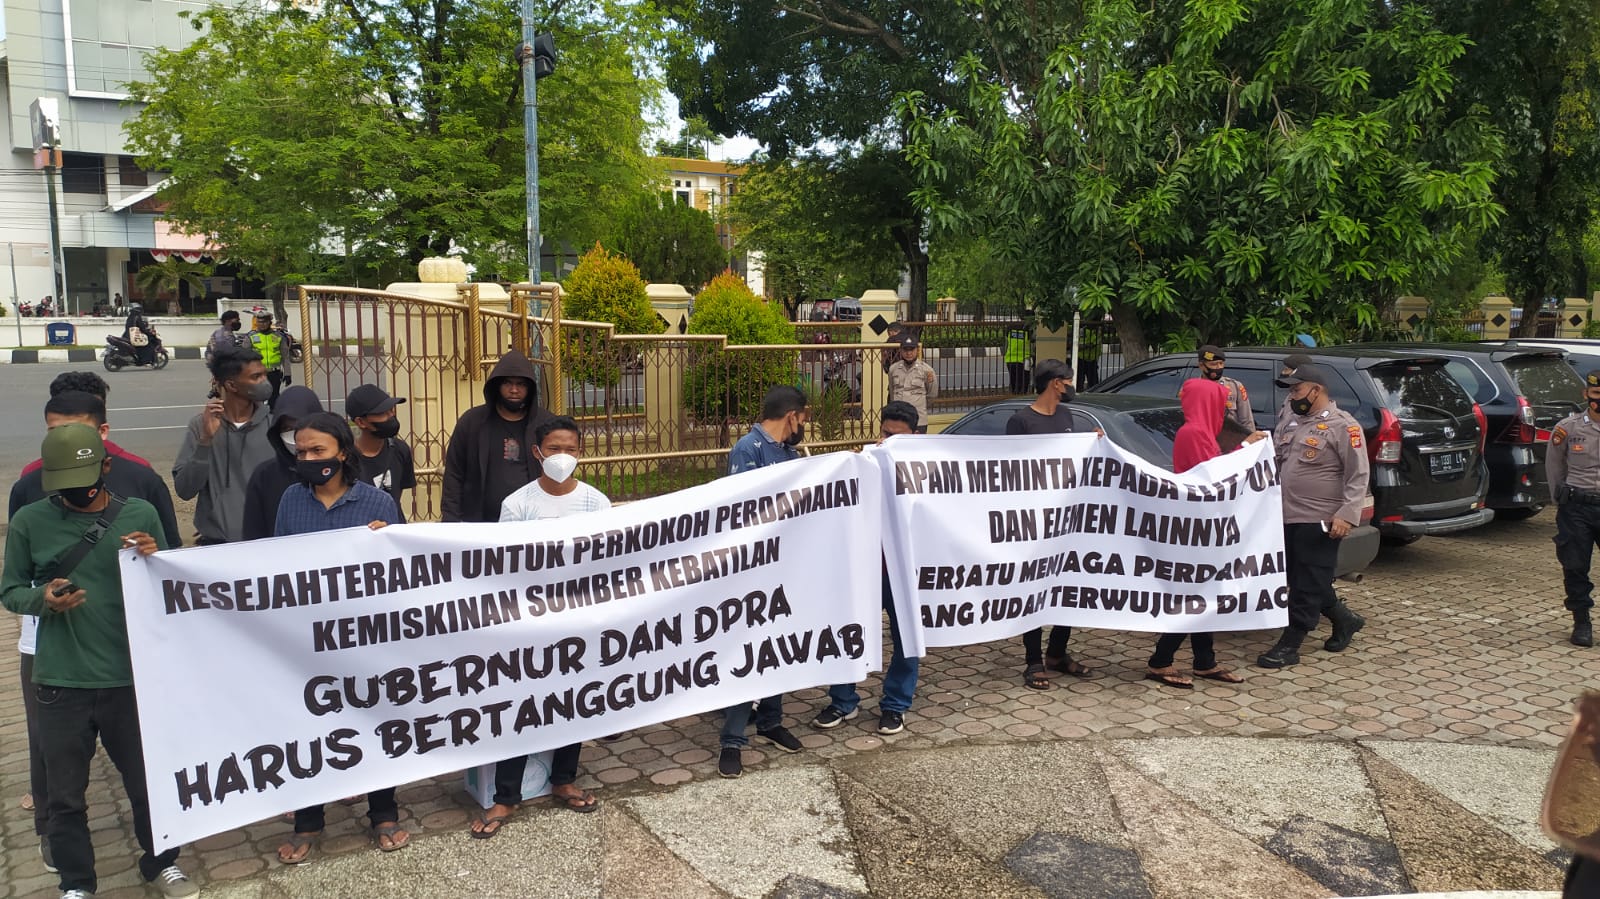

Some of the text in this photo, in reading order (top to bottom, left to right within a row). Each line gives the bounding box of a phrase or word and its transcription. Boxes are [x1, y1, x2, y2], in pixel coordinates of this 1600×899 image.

[966, 457, 1077, 494] MEMINTA
[1079, 456, 1179, 501] KEPADA
[162, 477, 860, 615] KESEJAHTERAAN UNTUK PERKOKOH PERDAMAIAN
[988, 503, 1241, 547] DAN ELEMEN LAINNYA
[313, 535, 781, 652] KEMISKINAN SUMBER KEBATILAN
[915, 561, 1015, 591] ERSATU
[1019, 551, 1126, 583] MENJAGA
[980, 589, 1048, 625] SUDAH
[1050, 586, 1207, 618] TERWUJUD
[1216, 592, 1248, 615] DI
[304, 583, 792, 716] GUBERNUR DAN DPRA
[174, 623, 865, 811] HARUS BERTANGGUNG JAWAB
